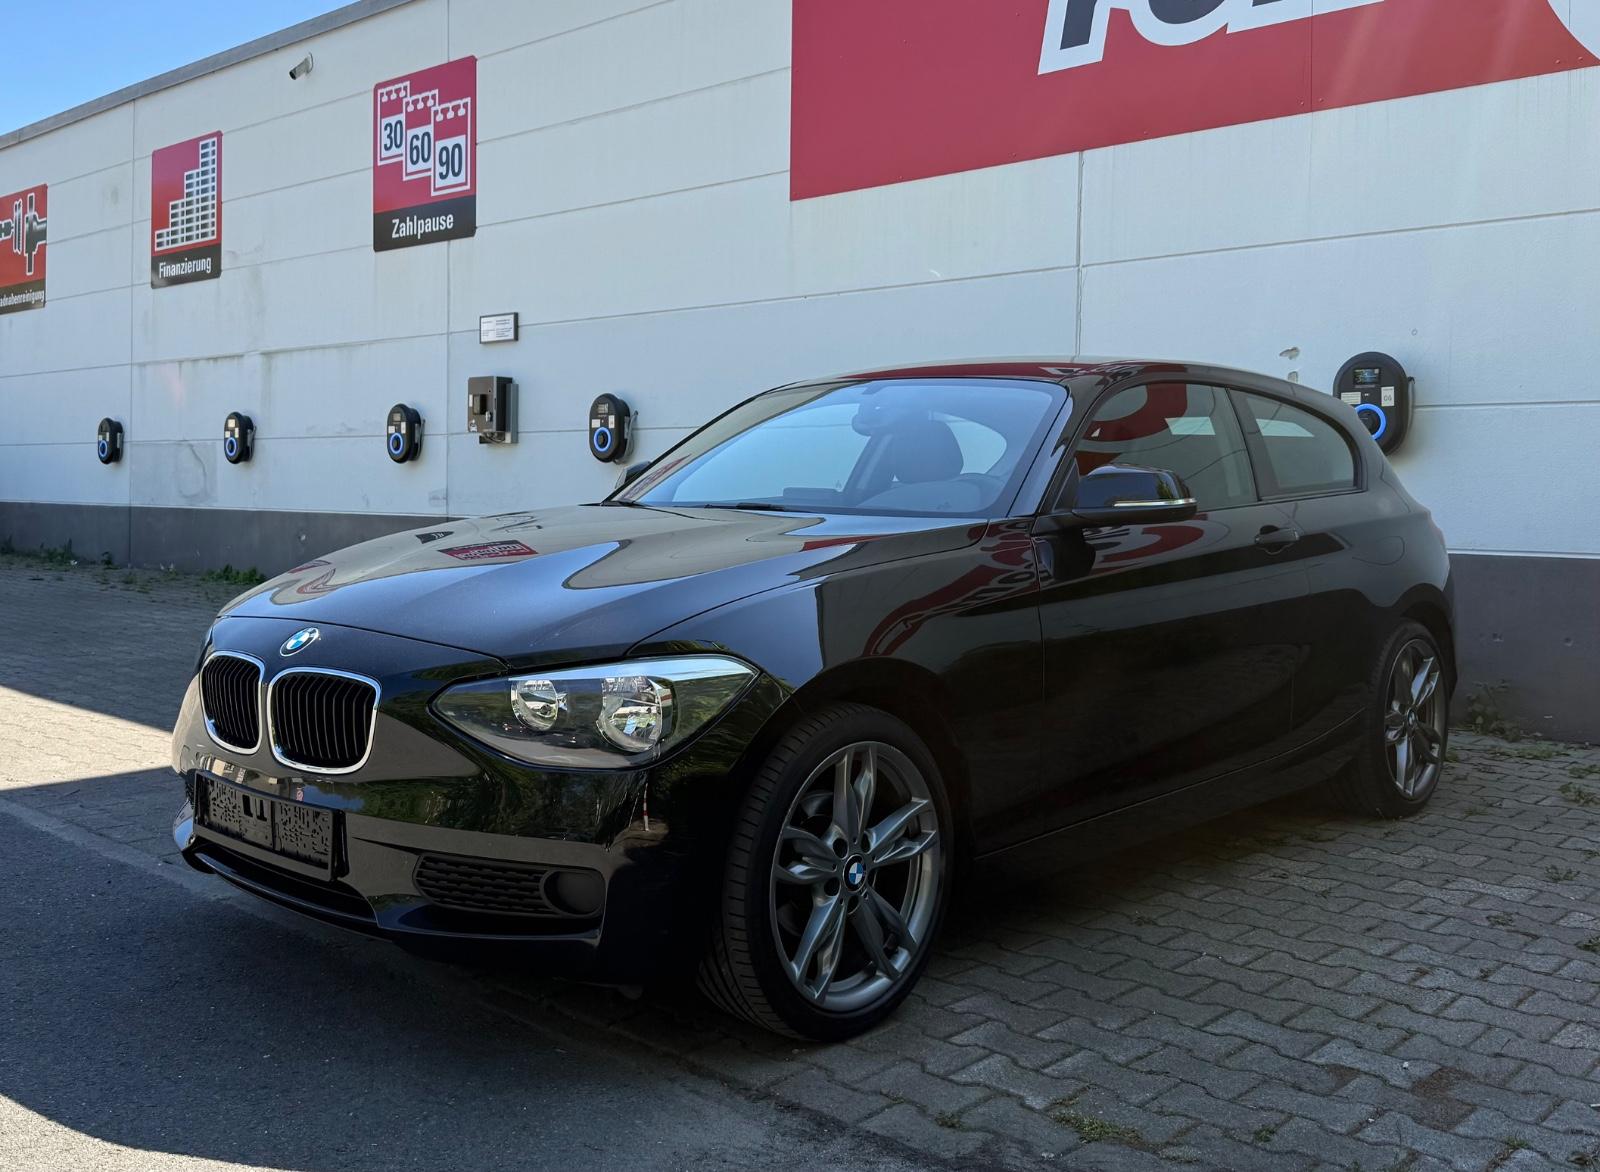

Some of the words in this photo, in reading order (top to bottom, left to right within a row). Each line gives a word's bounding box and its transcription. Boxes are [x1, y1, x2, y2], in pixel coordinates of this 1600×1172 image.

[383, 120, 403, 152] 30
[409, 131, 432, 166] 60
[438, 143, 463, 180] 90
[391, 213, 454, 240] Zahlpause
[158, 257, 212, 279] Finanzierung
